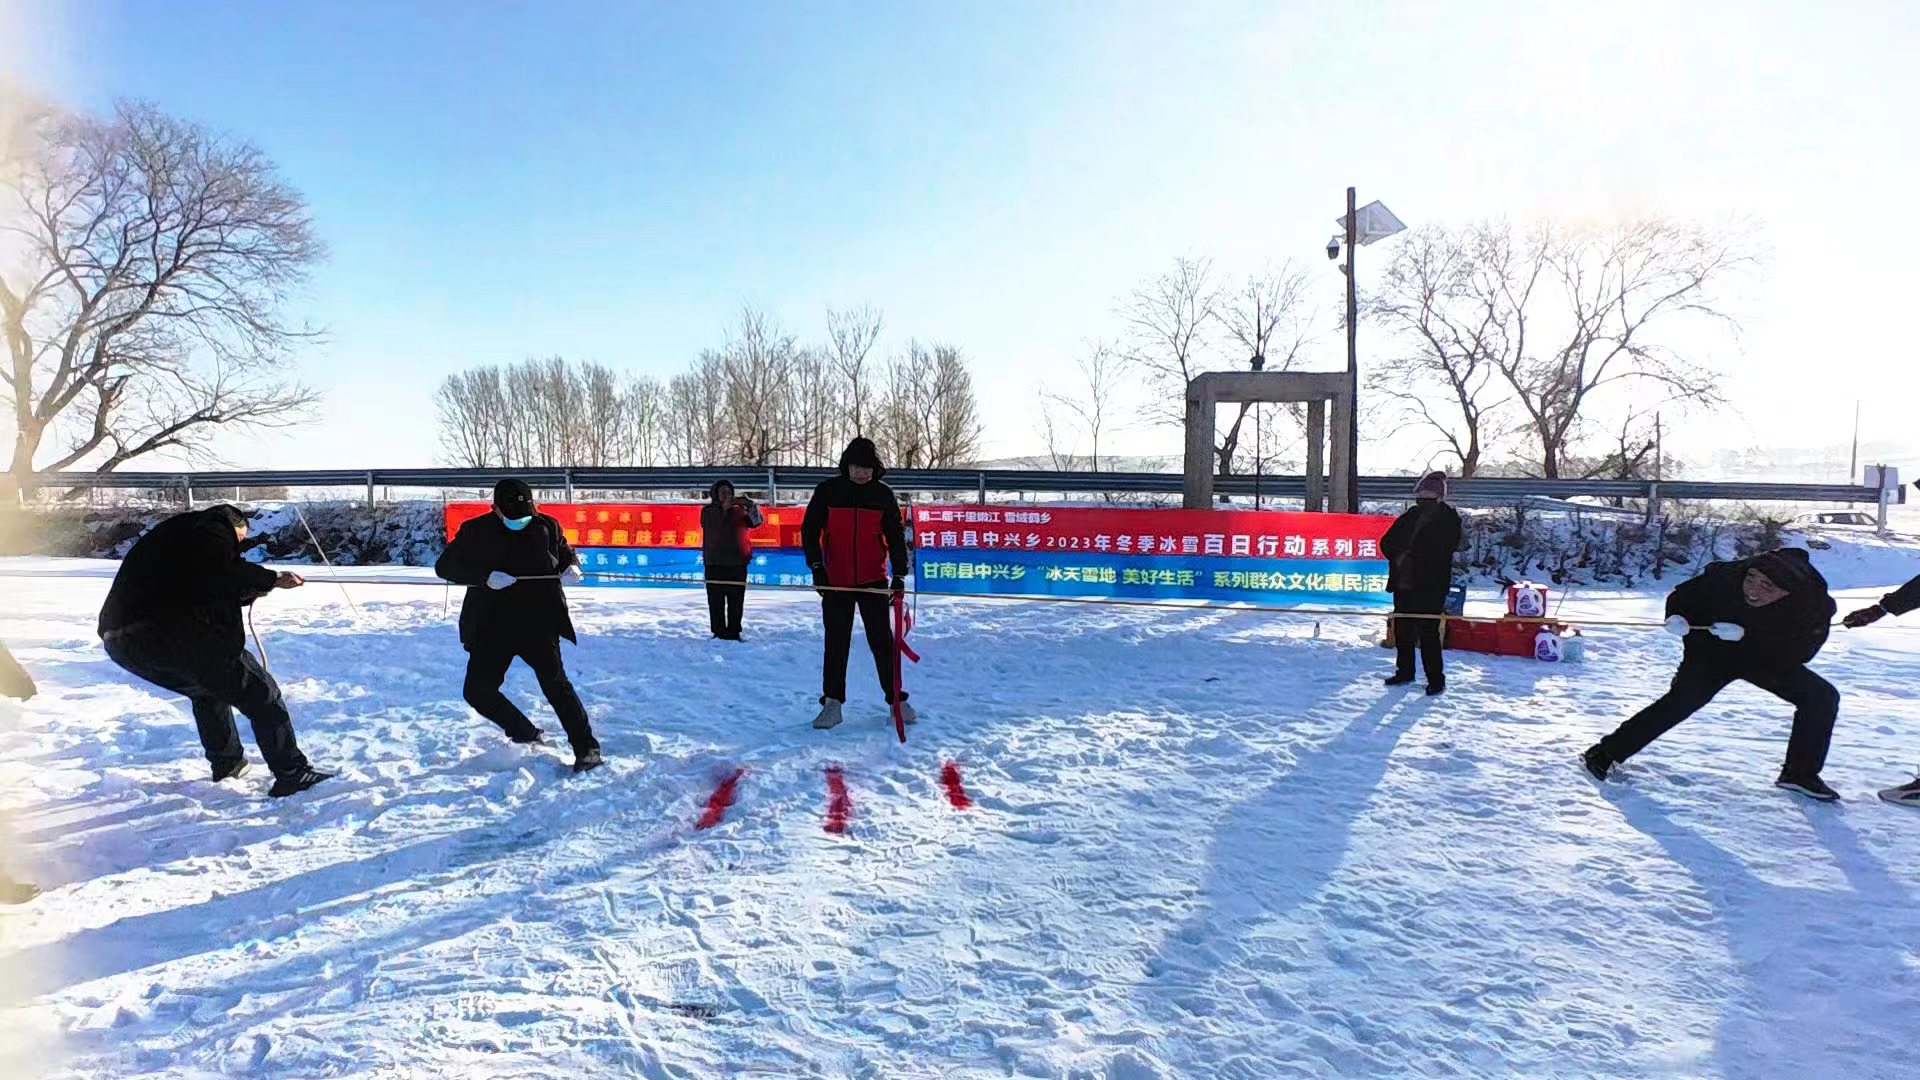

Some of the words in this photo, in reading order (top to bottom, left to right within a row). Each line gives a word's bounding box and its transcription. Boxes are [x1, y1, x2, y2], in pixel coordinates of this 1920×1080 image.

[922, 562, 1026, 580] 甘南县中兴乡
